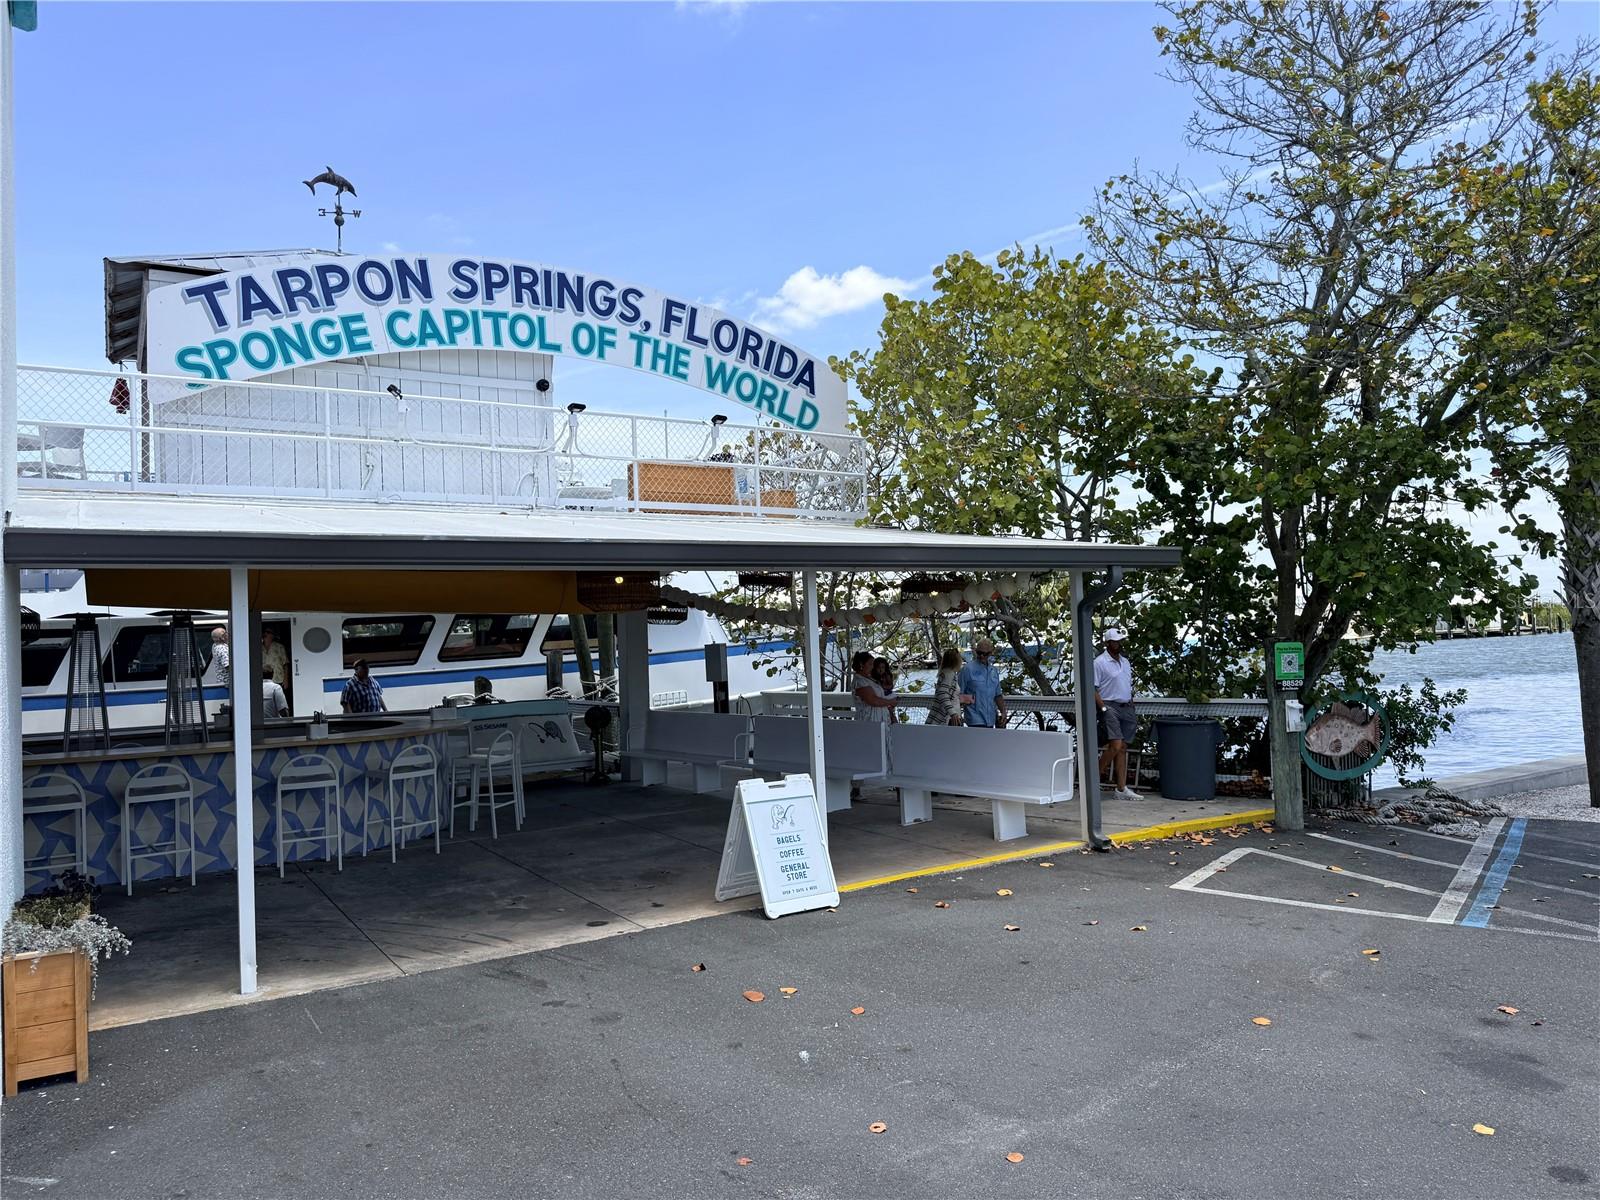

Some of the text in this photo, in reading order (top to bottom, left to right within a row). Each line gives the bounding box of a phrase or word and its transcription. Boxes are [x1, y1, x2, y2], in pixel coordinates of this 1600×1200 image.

[182, 258, 817, 397] TARPON SPRINGS, FLORIDA
[175, 308, 821, 431] SPONGE CAPITOL OF THE WORLD
[776, 835, 801, 844] BAGELS
[780, 848, 804, 858] COFFEE
[781, 862, 810, 873] GENERAL
[786, 871, 808, 881] STORE
